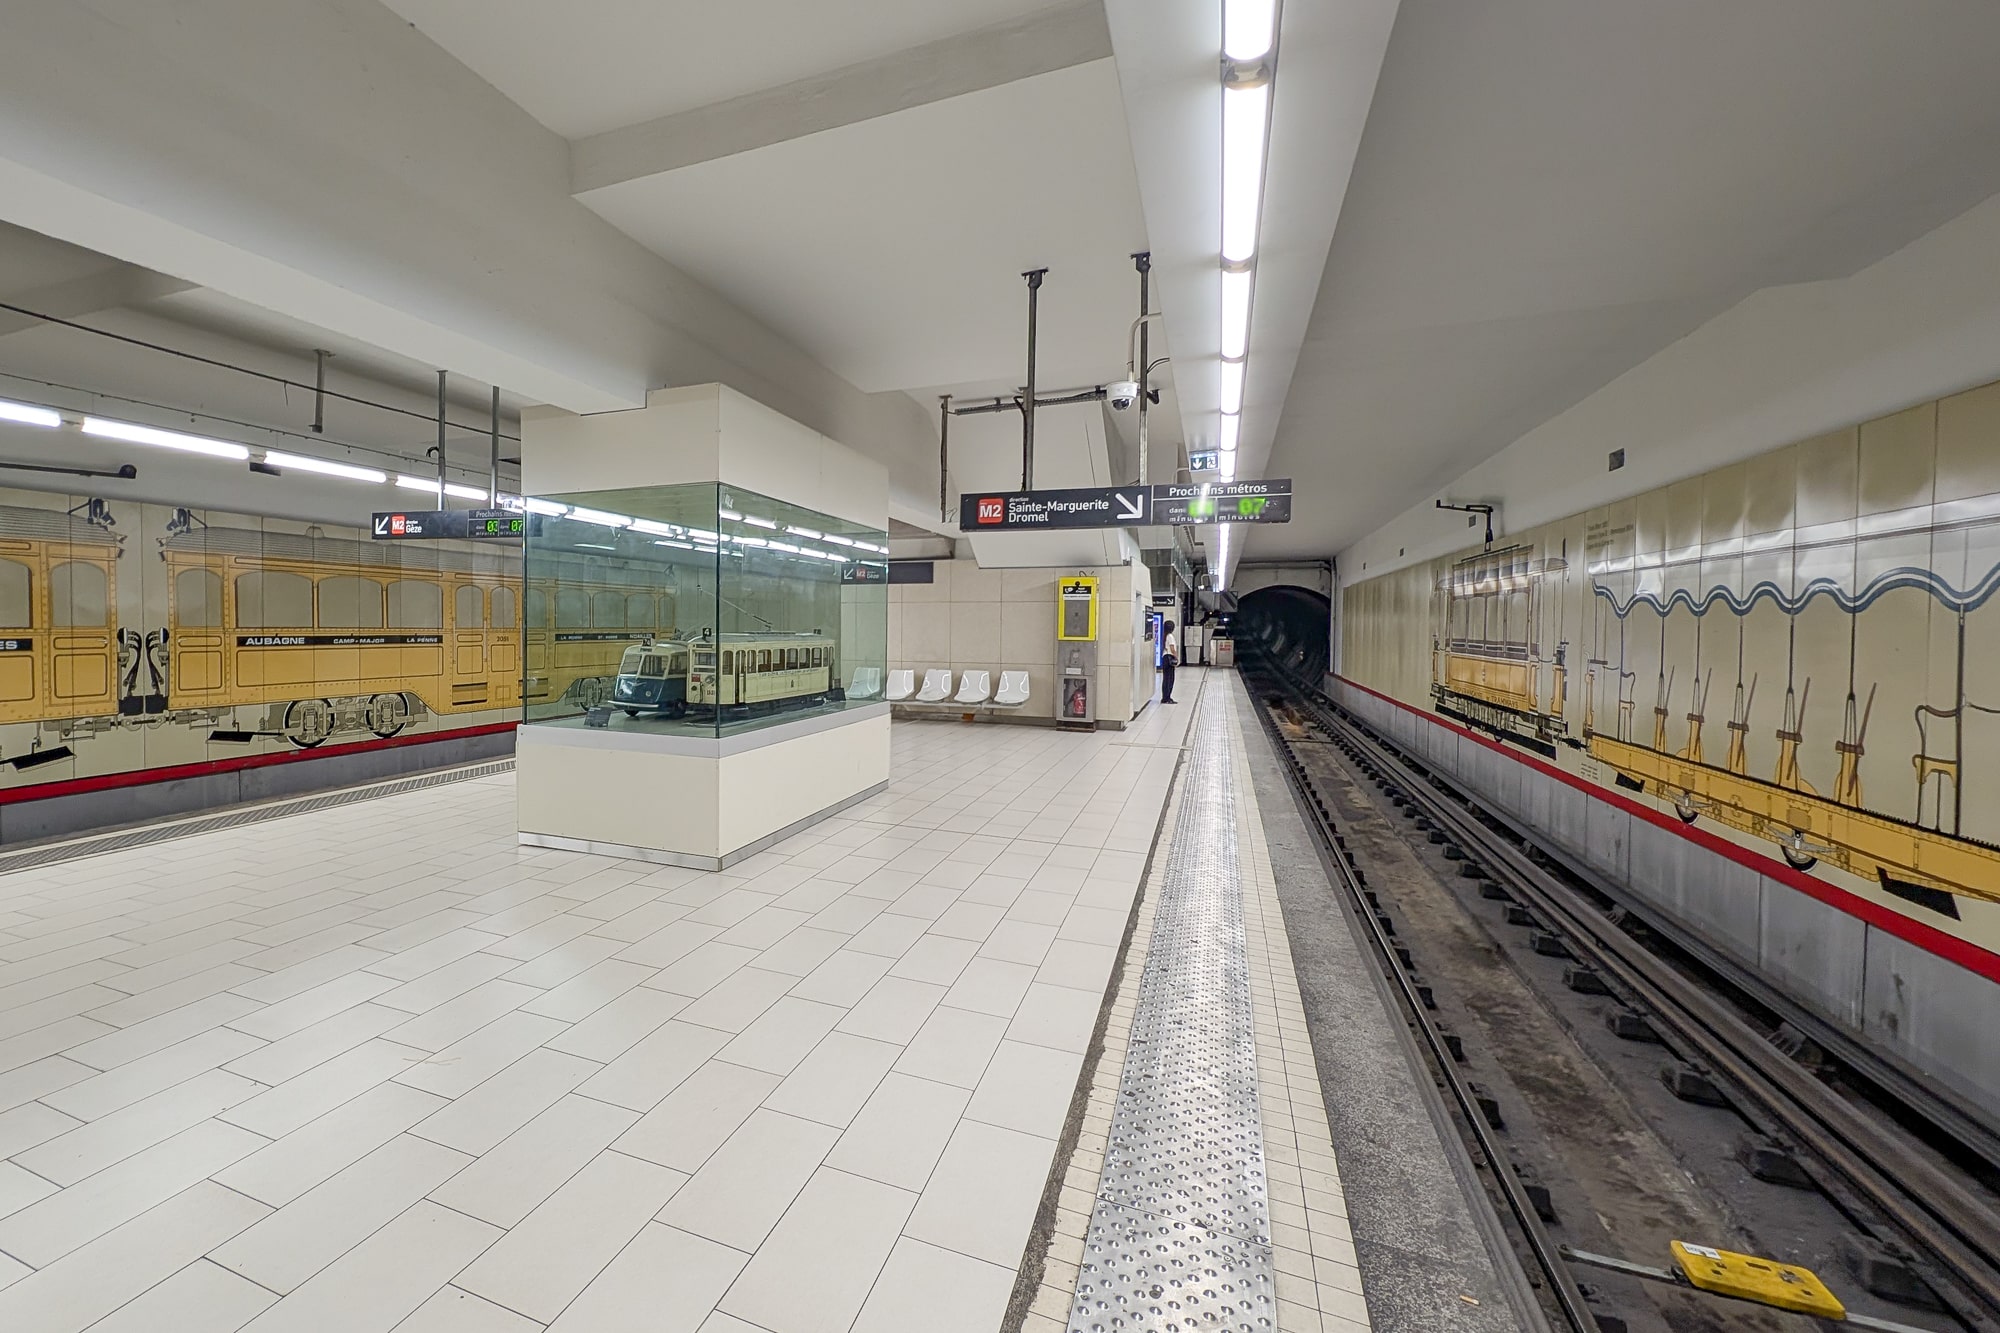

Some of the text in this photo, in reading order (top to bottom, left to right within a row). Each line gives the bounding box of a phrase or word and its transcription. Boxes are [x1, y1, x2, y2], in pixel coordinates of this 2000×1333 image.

[1169, 483, 1268, 497] Prochins métros
[979, 499, 1109, 518] M2 Sainte-Marguerite
[1008, 511, 1049, 522] Dromel
[392, 520, 422, 533] M2 Gèze
[511, 520, 523, 531] 07
[245, 636, 305, 646] AUBAGNE
